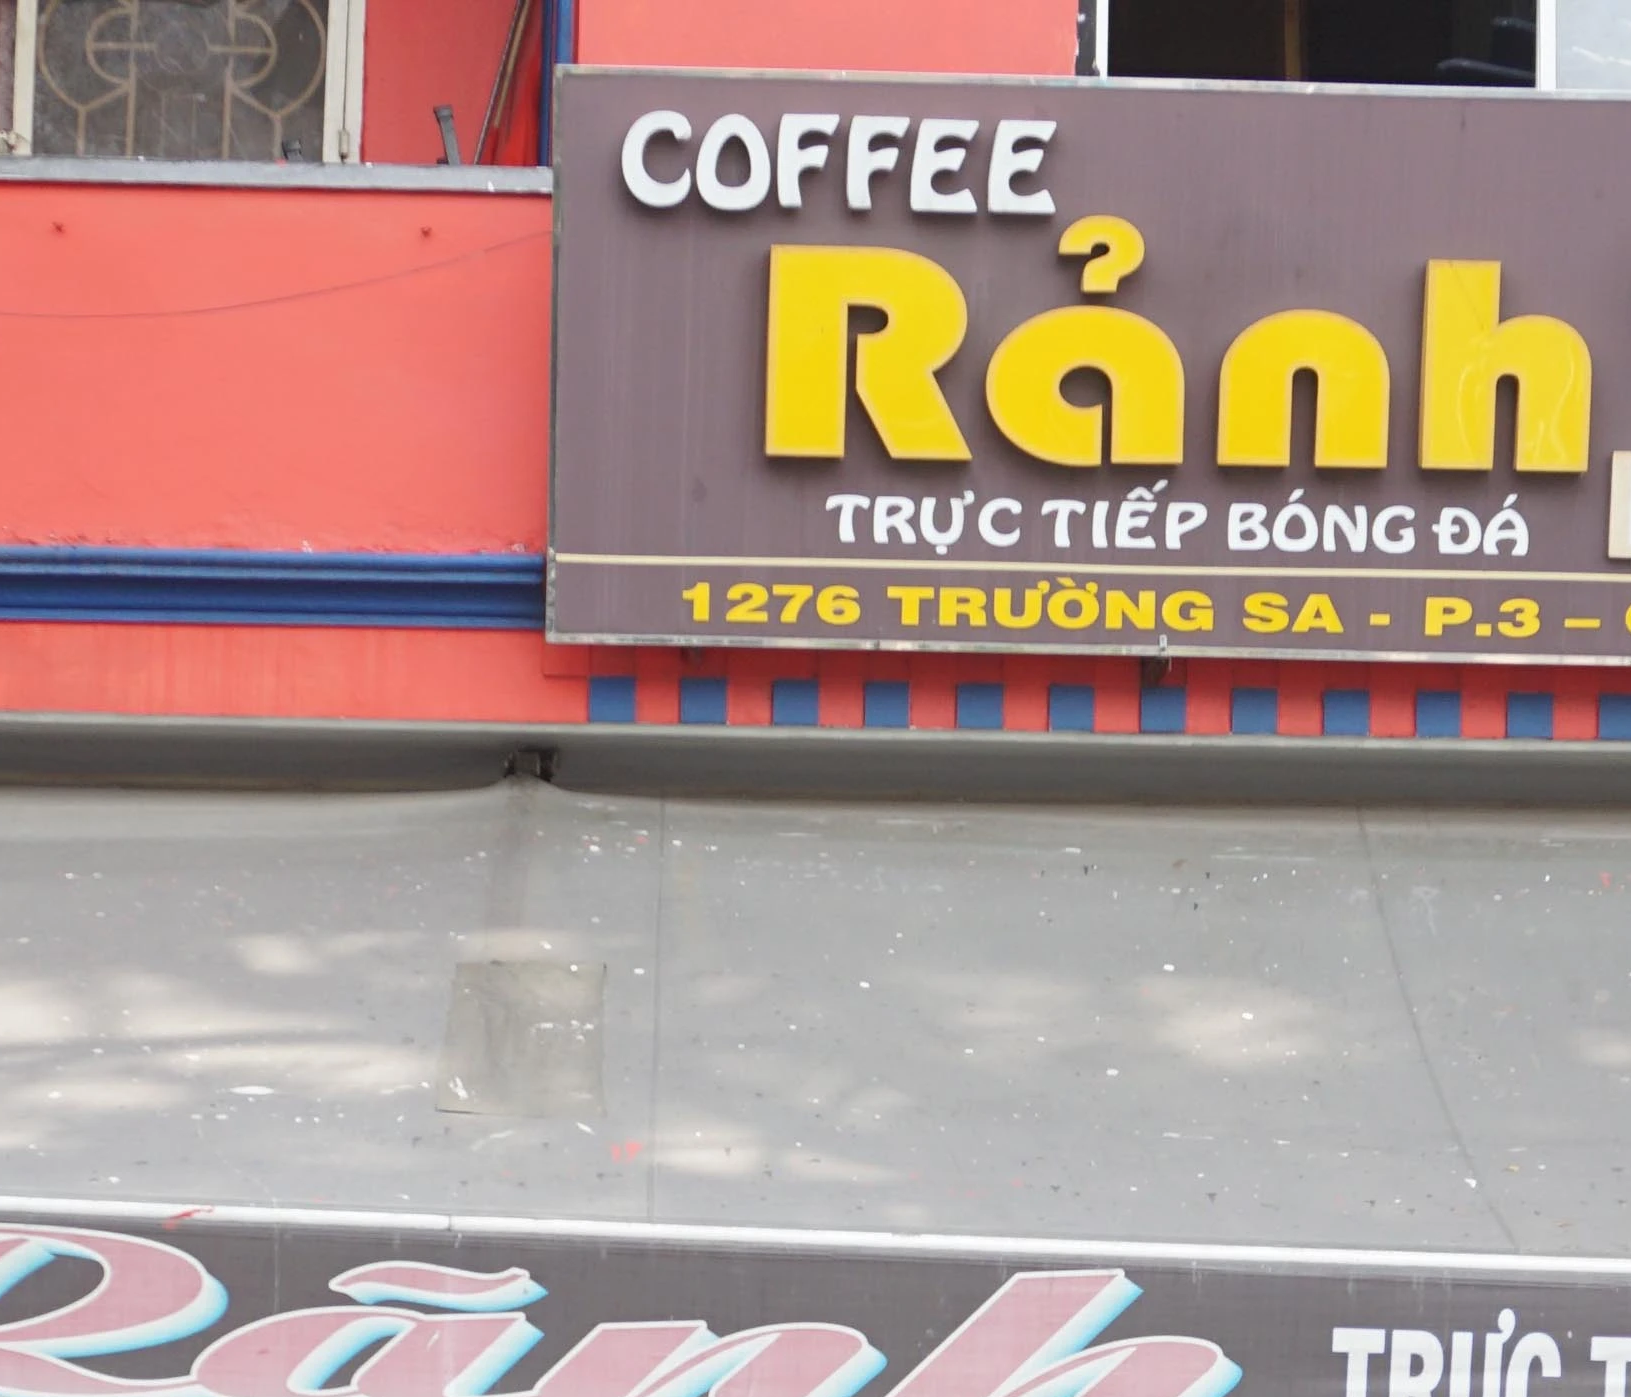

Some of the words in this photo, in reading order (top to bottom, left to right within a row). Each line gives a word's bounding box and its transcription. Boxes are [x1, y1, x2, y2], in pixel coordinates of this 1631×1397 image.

[620, 109, 1058, 214] COFFEE
[764, 214, 1593, 473] Rảnh
[825, 489, 1022, 555] TRỰC
[1041, 480, 1209, 552] TIẾP
[1227, 488, 1415, 554] BÓNG
[1431, 493, 1529, 556] ĐÁ
[682, 582, 861, 625] 1276
[887, 577, 1214, 632] TRƯỜNG
[1243, 592, 1344, 633] SA
[1424, 597, 1540, 638] P.3
